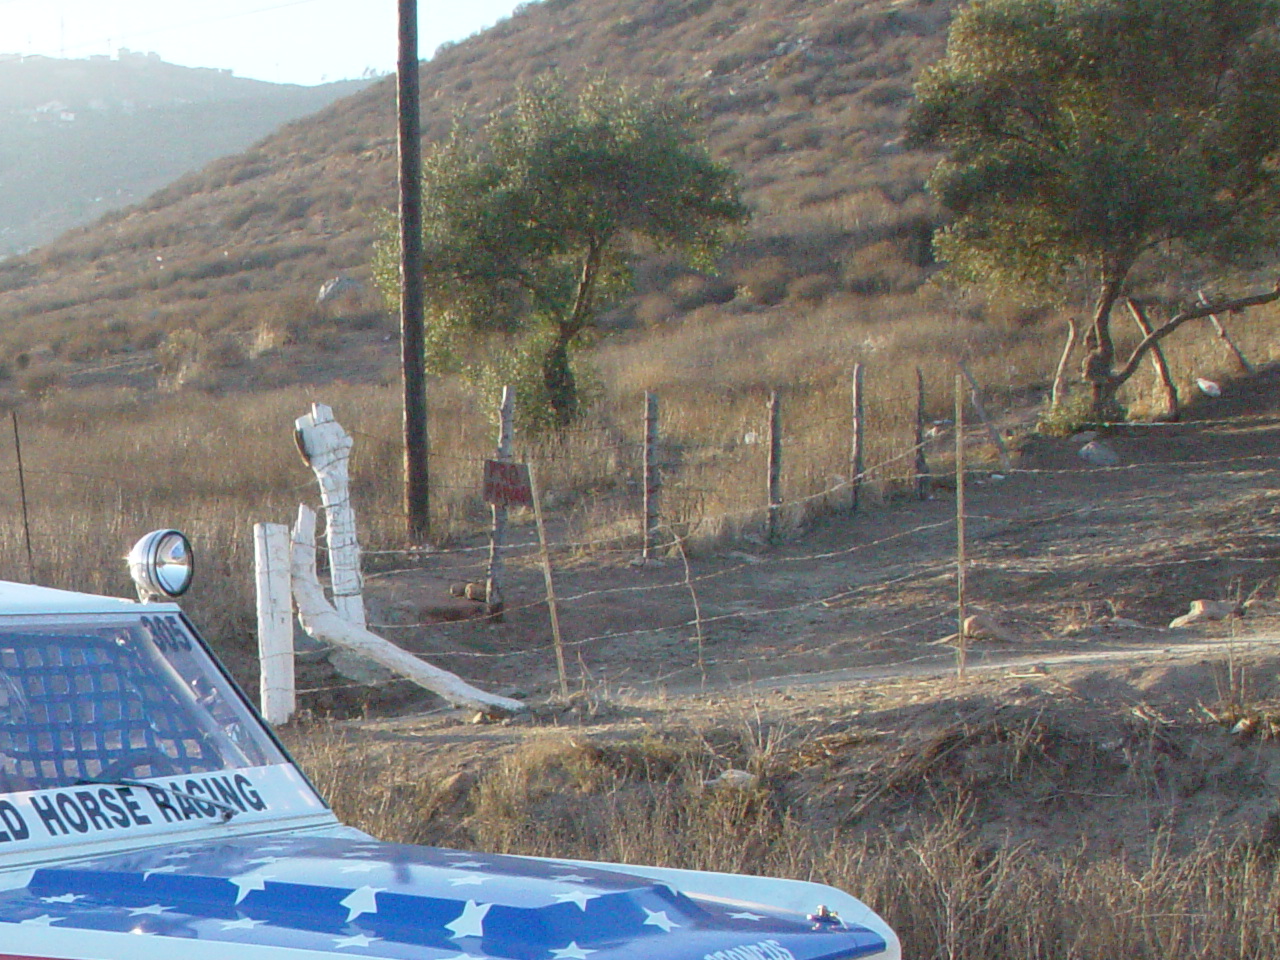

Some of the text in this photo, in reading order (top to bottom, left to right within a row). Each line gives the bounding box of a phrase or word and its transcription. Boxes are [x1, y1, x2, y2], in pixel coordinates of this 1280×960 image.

[140, 615, 192, 652] 305
[30, 787, 151, 836] HORSE
[147, 773, 267, 823] RACING
